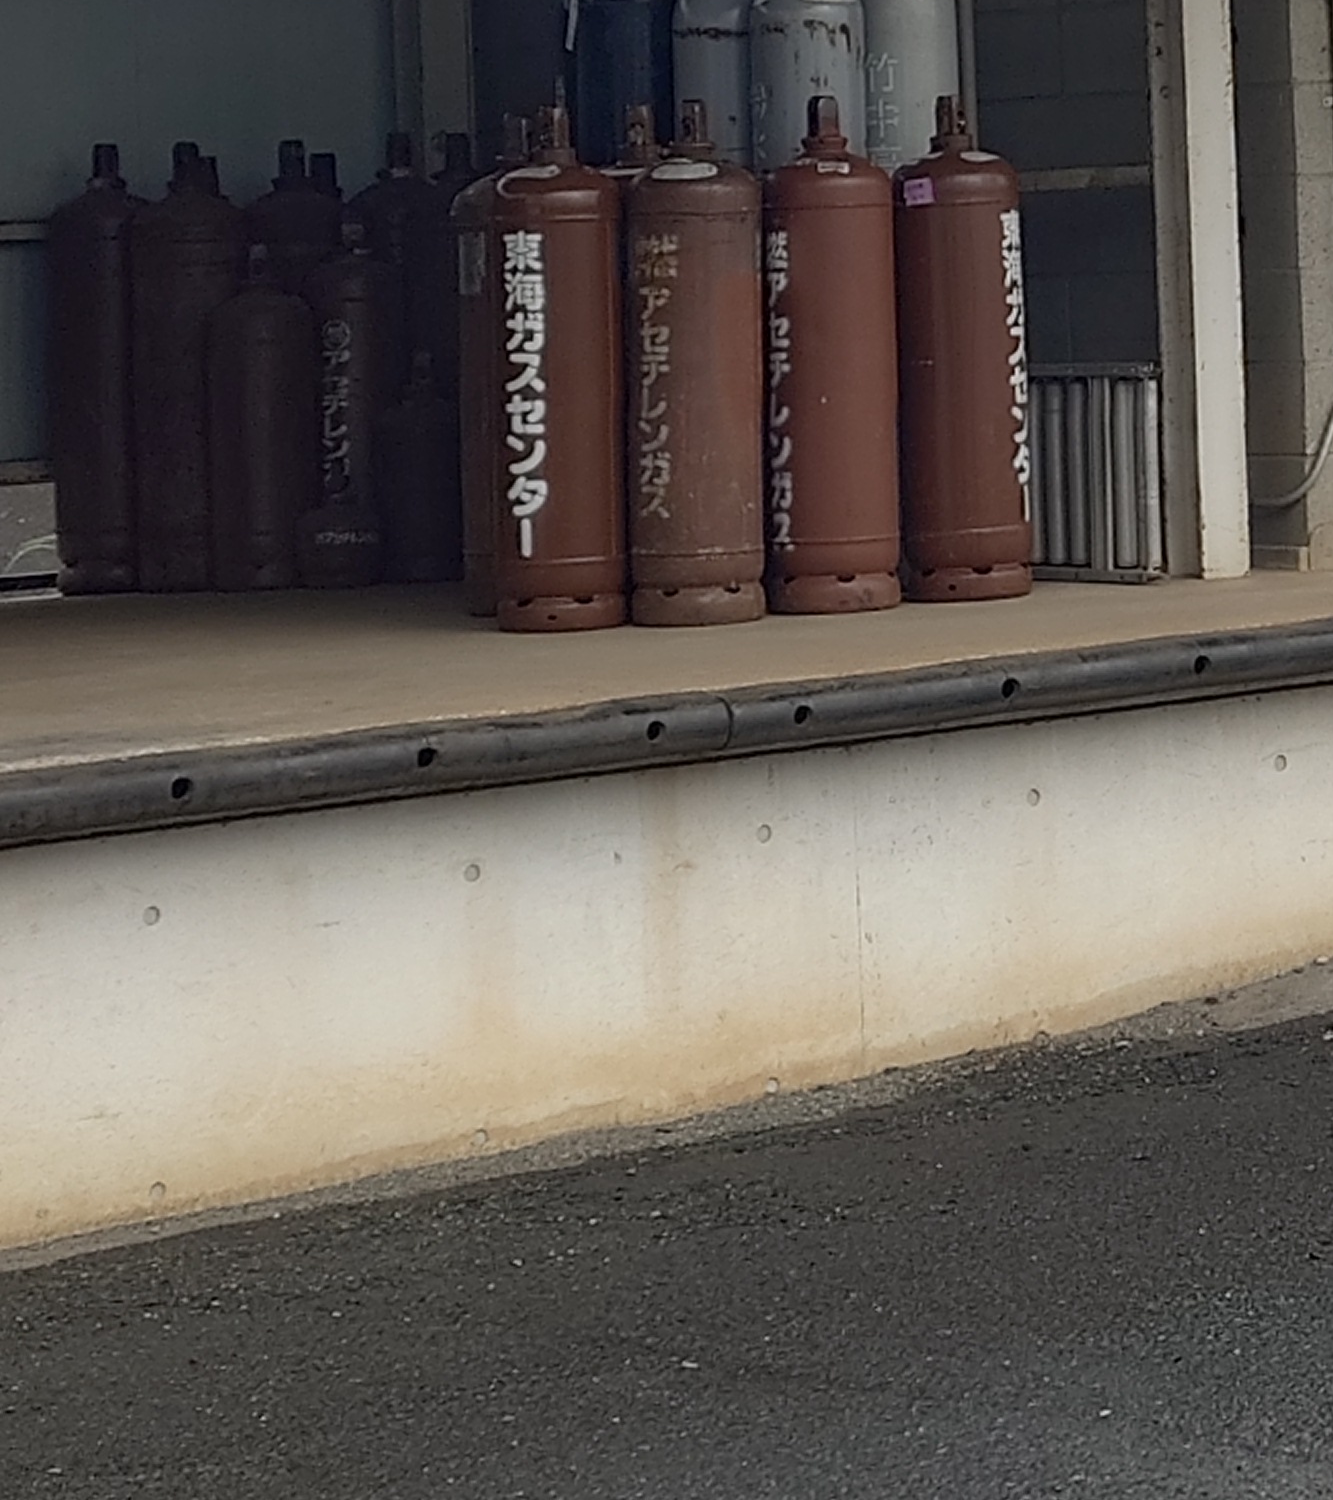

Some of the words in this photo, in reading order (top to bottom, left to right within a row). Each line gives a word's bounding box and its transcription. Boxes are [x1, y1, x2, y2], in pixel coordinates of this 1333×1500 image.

[503, 229, 548, 558] 東海ガスセンター
